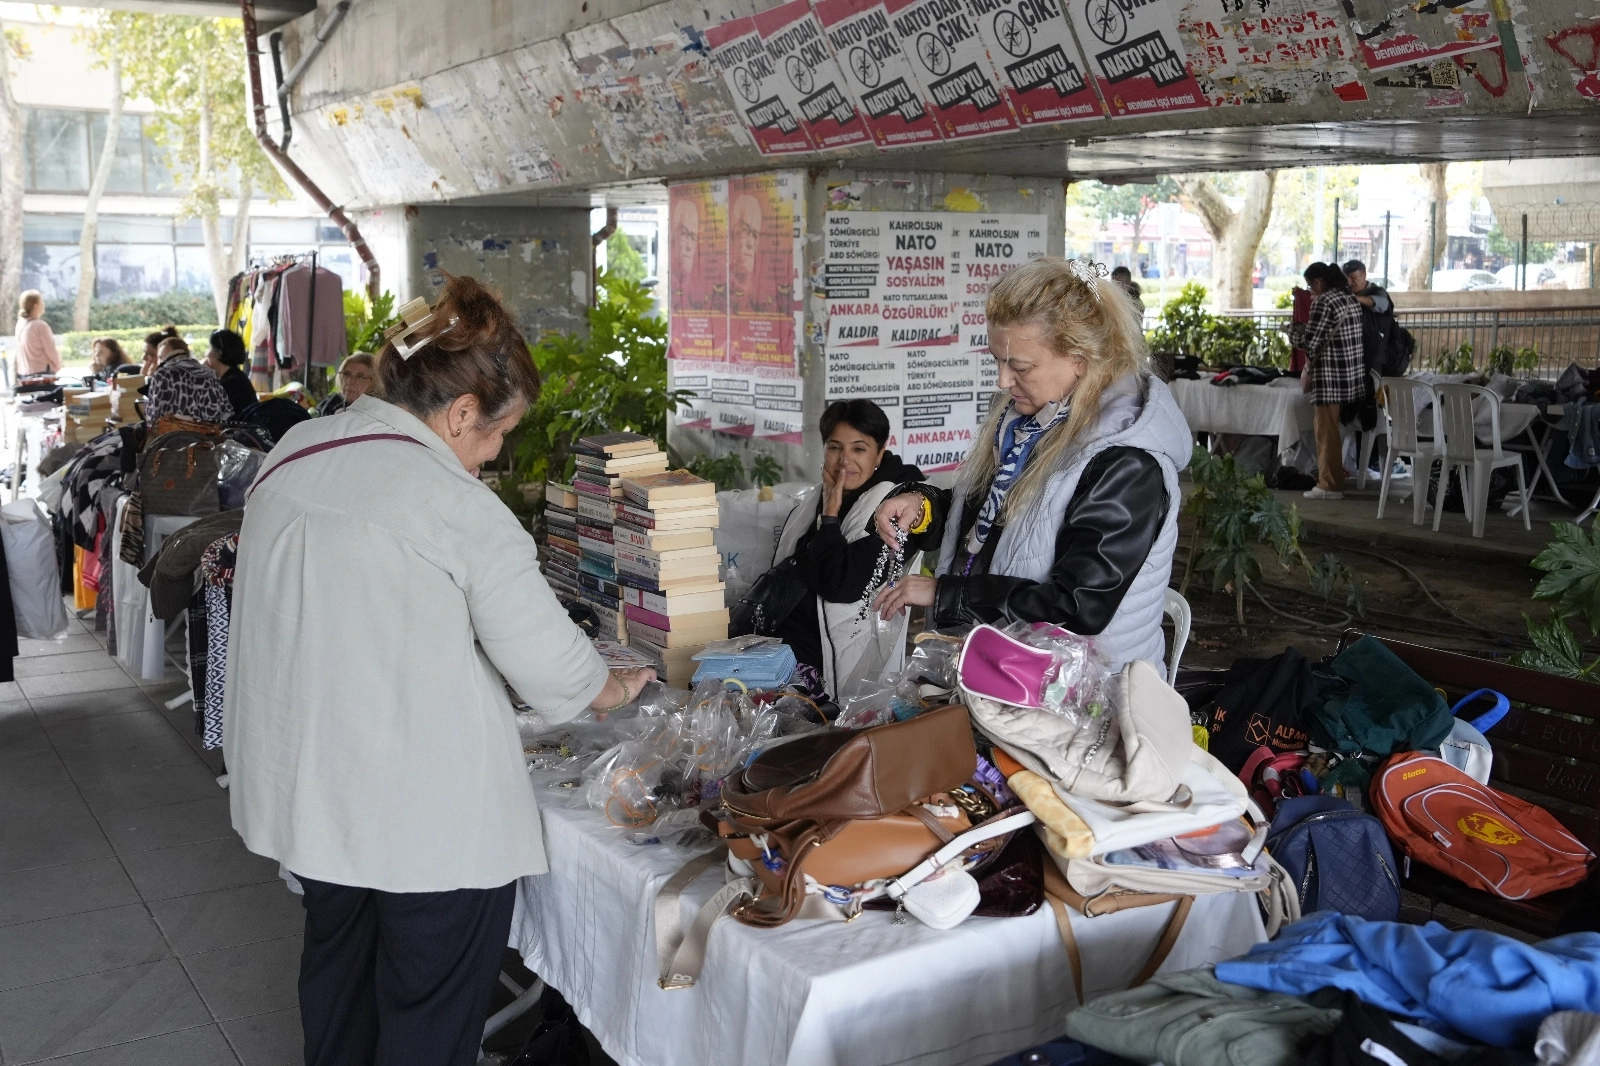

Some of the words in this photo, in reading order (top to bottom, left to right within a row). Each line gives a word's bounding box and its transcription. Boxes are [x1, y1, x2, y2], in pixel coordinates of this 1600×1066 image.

[1018, 0, 1060, 34] ÇIK!
[828, 9, 889, 51] NATO'DAN
[937, 13, 975, 53] ÇIK!
[766, 18, 818, 61] NATO'DAN
[716, 34, 765, 70] NATO'DAN
[800, 39, 830, 74] ÇIK!
[867, 32, 901, 68] ÇIK!
[1102, 37, 1167, 79] NATO'YU
[1374, 41, 1415, 61] DEVRİMCİ
[748, 54, 775, 86] ÇIK!
[1010, 50, 1067, 89] NATO'YU
[1149, 58, 1182, 83] YIK!
[933, 68, 983, 105] NATO'YU
[1052, 70, 1079, 93] YIK!
[802, 87, 841, 120] NATO'YU
[865, 83, 910, 116] NATO'YU
[970, 85, 998, 109] YIK!
[1127, 97, 1157, 111] DEVRİMCİ
[1157, 96, 1170, 110] İŞÇİ
[1170, 93, 1196, 105] PARTİSİ
[750, 100, 786, 129] NATO'YU
[831, 103, 854, 123] YIK!
[900, 99, 922, 120] YIK!
[776, 115, 797, 132] YIK!
[830, 217, 849, 225] NATO
[889, 221, 943, 230] KAHROLSUN
[896, 235, 936, 250] NATO
[969, 229, 1019, 239] KAHROLSUN
[829, 239, 860, 248] TÜRKİYE
[975, 243, 1013, 258] NATO
[846, 250, 879, 259] SÖMÜRG
[886, 256, 945, 274] YAŞASIN
[886, 273, 945, 288] SOSYALİZM
[902, 293, 948, 301] TUTSAKLARINA
[830, 303, 879, 316] ANKARA
[882, 304, 948, 320] ÖZGÜRLÜK!
[839, 326, 879, 339] KALDIR
[829, 361, 895, 372] SÖMÜRGECİLİKTİR
[907, 358, 969, 369] SÖMÜRGECİLİKTİR
[829, 374, 859, 383] TÜRKİYE
[907, 371, 936, 380] TÜRKİYE
[922, 379, 974, 389] SÖMÜRGESİDİR
[829, 386, 844, 394] ABD
[845, 384, 900, 394] SÖMÜRGESİDİR
[907, 429, 971, 445] ANKARA'YA
[1275, 724, 1295, 739] ALP
